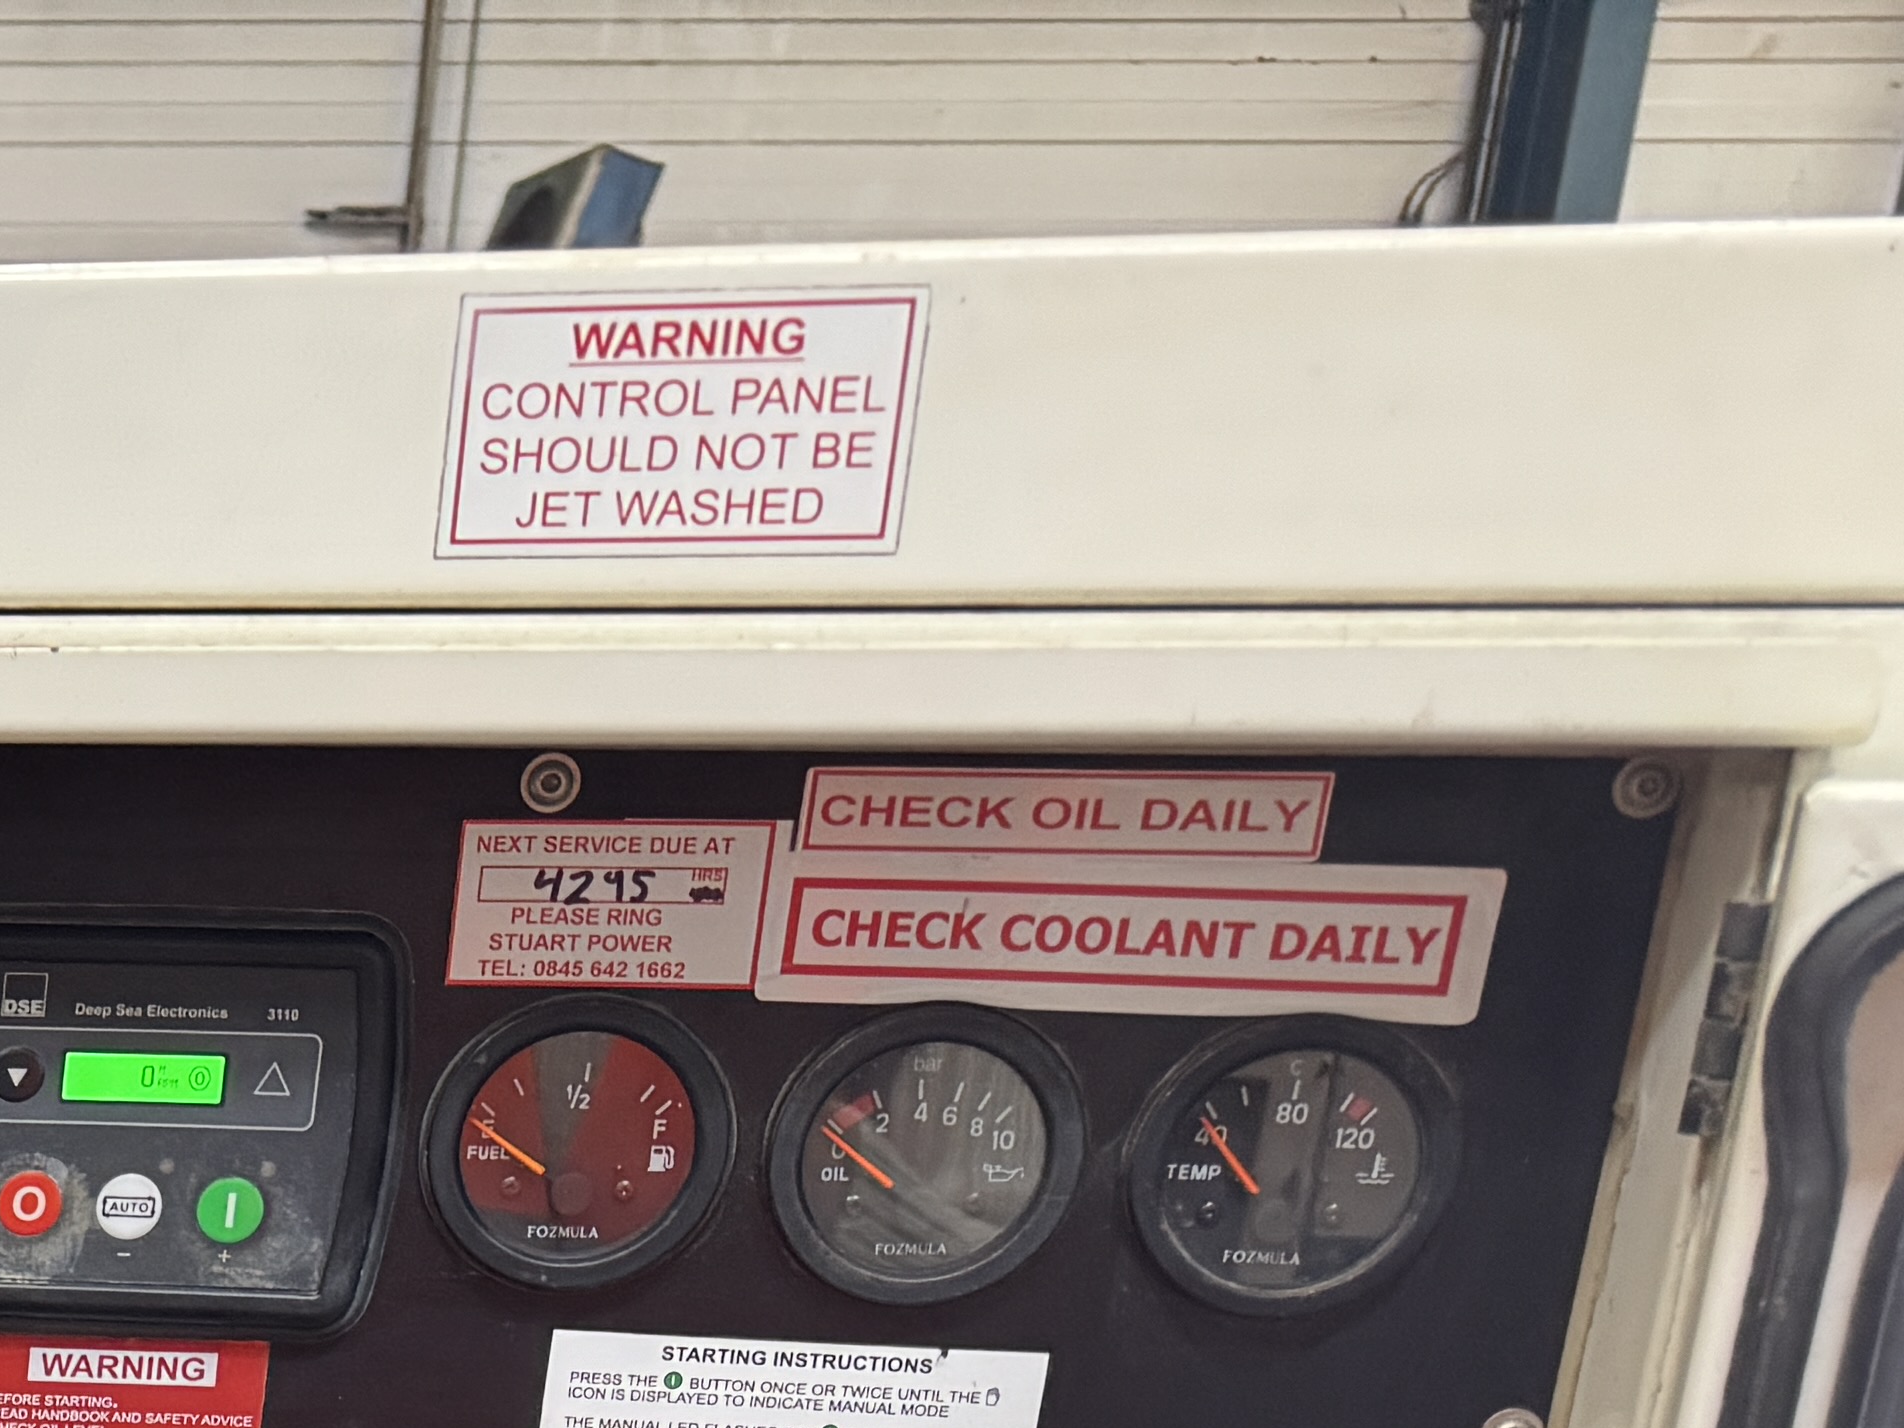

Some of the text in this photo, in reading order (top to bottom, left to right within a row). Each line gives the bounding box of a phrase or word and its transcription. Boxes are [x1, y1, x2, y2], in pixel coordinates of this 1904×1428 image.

[572, 318, 806, 358] WARNING
[482, 376, 885, 420] CONTROL PANEL
[480, 431, 876, 474] SHOULD NOT BE
[515, 487, 823, 527] JET WASHED
[821, 795, 1312, 832] CHECK OIL DAILY
[477, 836, 735, 855] NEXT SERVICE DUE AT
[511, 908, 662, 926] PLEASE RING
[489, 934, 672, 952] STUART POWER
[811, 908, 1442, 965] CHECK COOLANT DAILY
[478, 960, 685, 979] TEL: 0845 642 1662
[4, 1000, 44, 1014] DSE
[75, 1003, 111, 1018] Deep
[116, 1004, 143, 1017] Sea
[147, 1005, 228, 1019] Electronics
[914, 1056, 943, 1072] bar
[1276, 1103, 1309, 1124] 80
[992, 1130, 1015, 1150] 10
[1335, 1128, 1375, 1149] 120
[467, 1146, 510, 1160] FUEL
[821, 1167, 848, 1181] OIL
[1167, 1163, 1221, 1181] TEMP
[110, 1202, 148, 1213] AUTO
[527, 1226, 598, 1239] FOZMULA
[875, 1243, 946, 1255] FOZMULA
[1222, 1250, 1300, 1265] FOZMULA
[42, 1353, 206, 1381] WARNING
[662, 1346, 933, 1374] STARTING INSTRUCTIONS
[570, 1372, 981, 1404] PRESS THE BUTTON ONCE OR TWICE UNTIL THE
[568, 1387, 950, 1418] ICON IS DISPLAYED TO INDICATE MANUAL MODE
[32, 1410, 110, 1422] HANDBOOK
[112, 1412, 142, 1423] AND
[145, 1413, 200, 1425] SAFETY
[201, 1415, 253, 1428] ADVICE
[564, 1417, 593, 1428] THE
